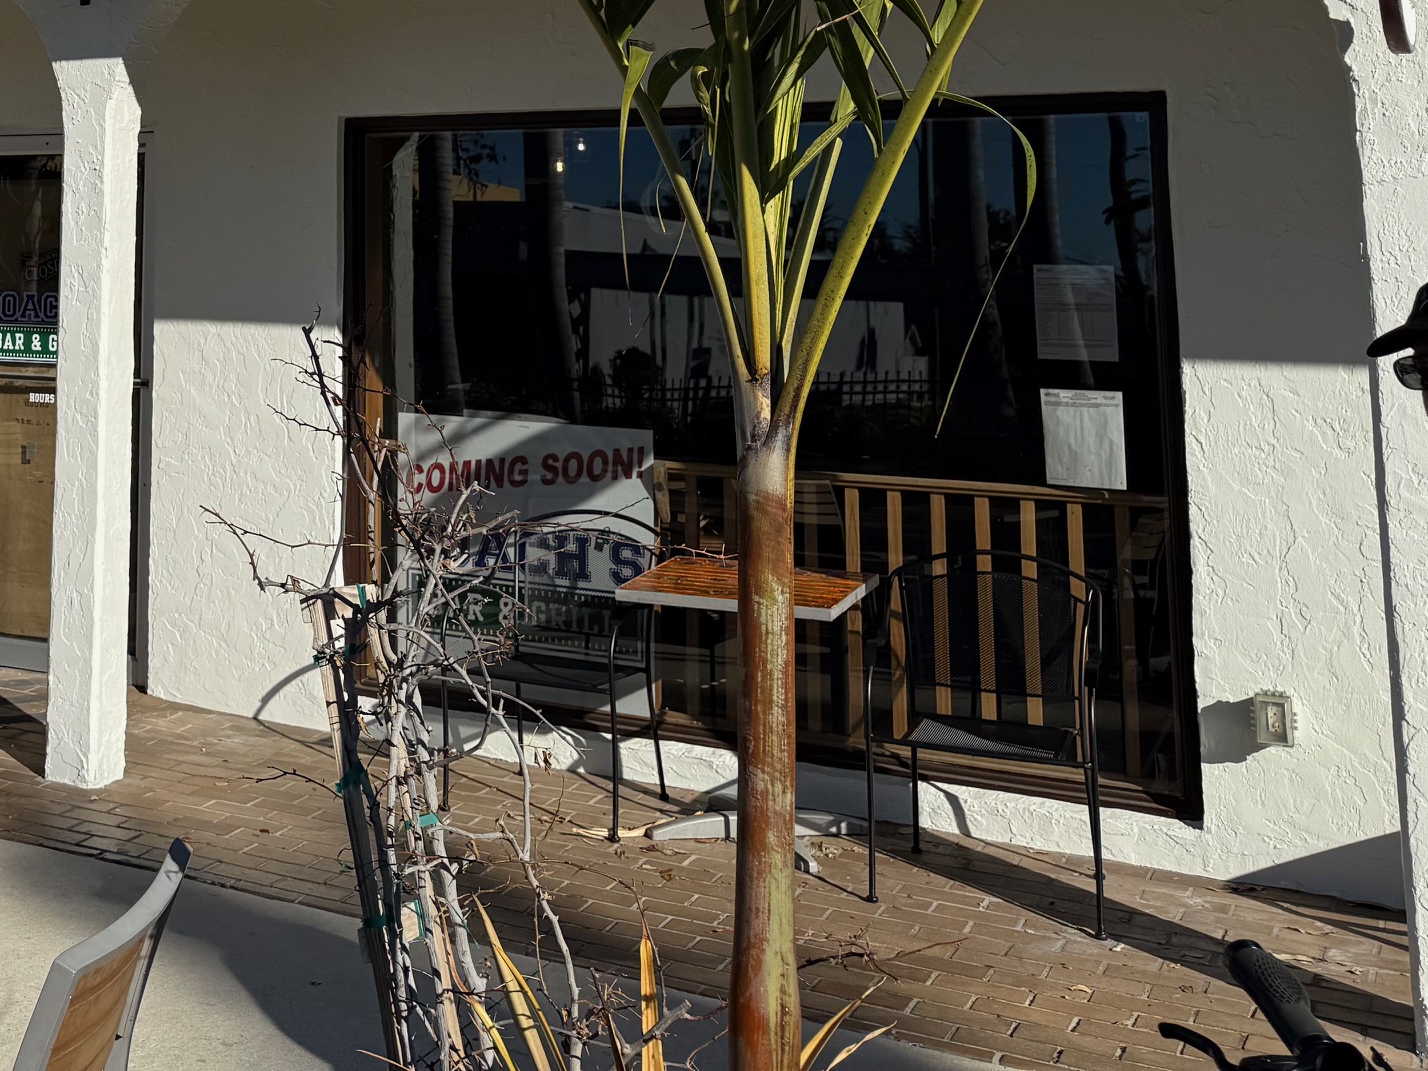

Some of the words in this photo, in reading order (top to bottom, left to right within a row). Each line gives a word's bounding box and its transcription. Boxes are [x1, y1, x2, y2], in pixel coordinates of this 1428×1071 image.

[31, 334, 41, 351] &
[29, 393, 55, 404] HOURS
[406, 457, 529, 494] COMING
[540, 446, 645, 486] SOON!
